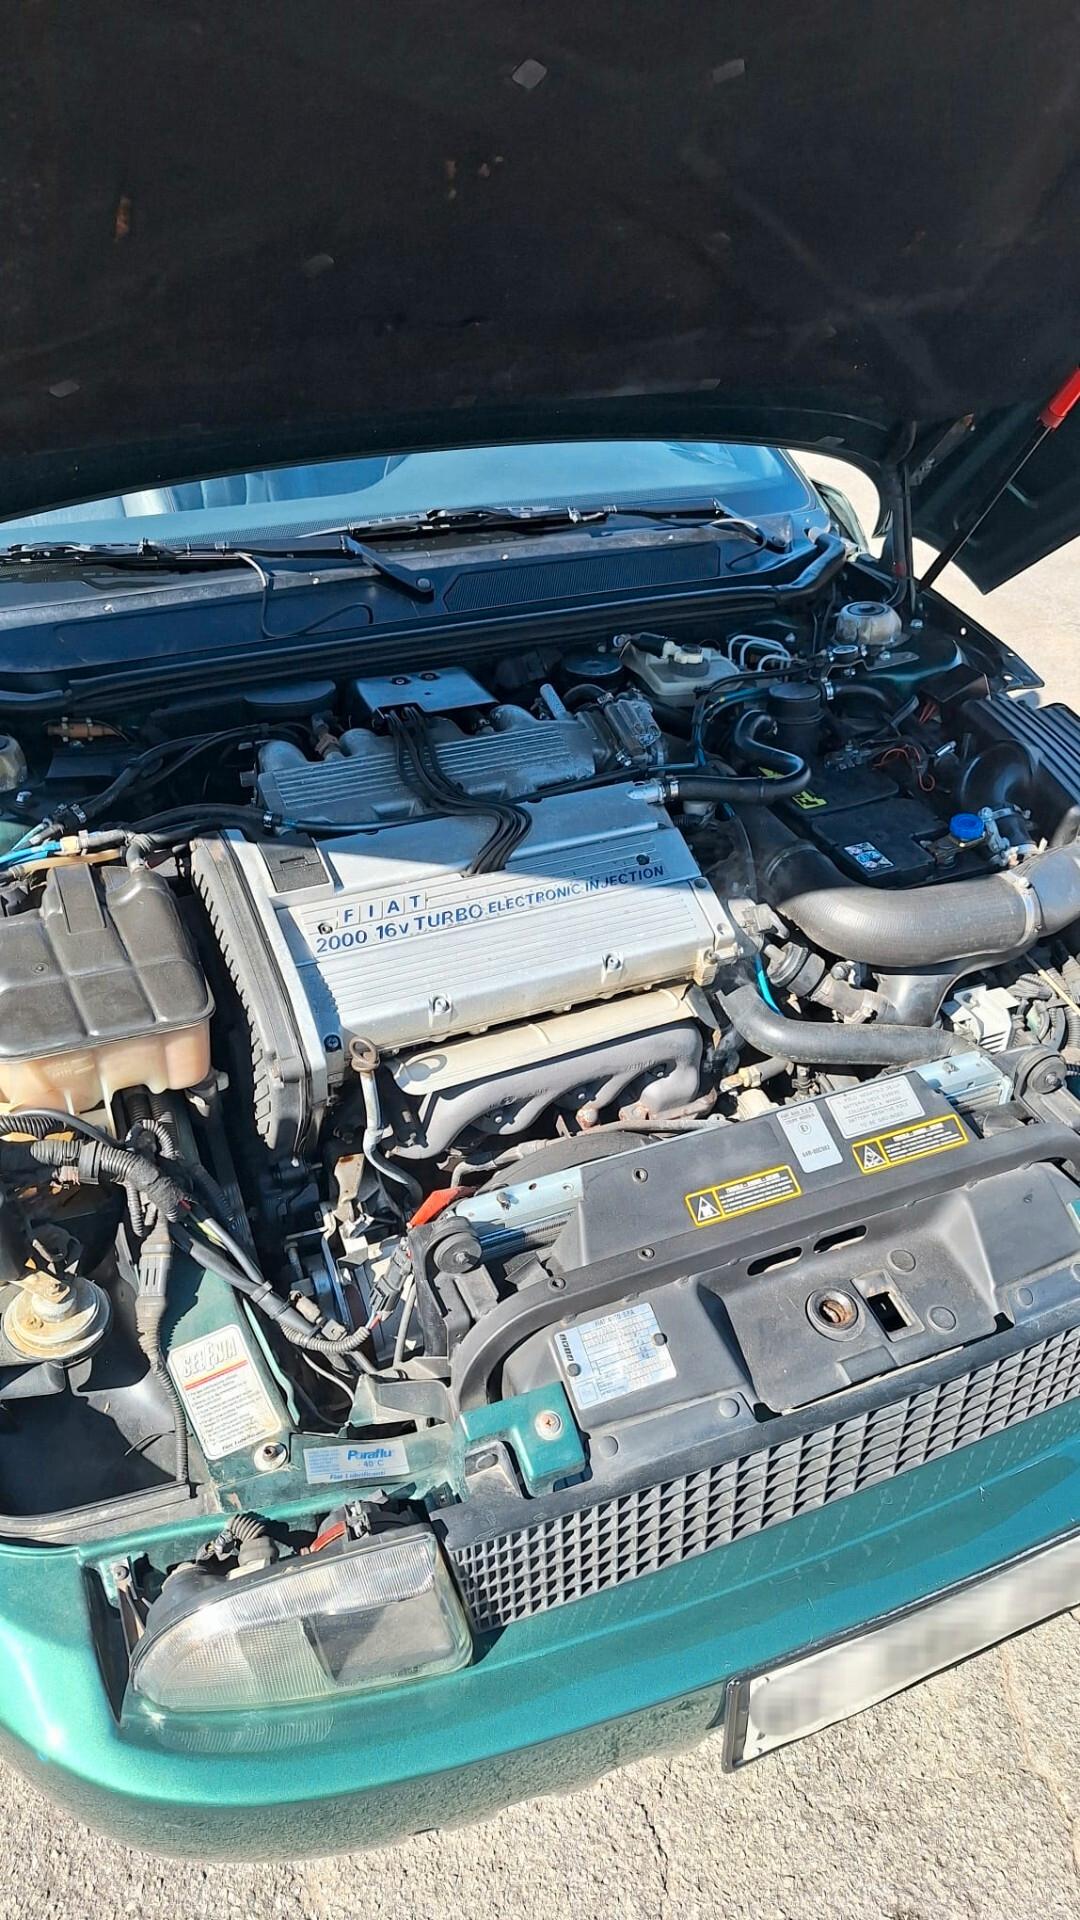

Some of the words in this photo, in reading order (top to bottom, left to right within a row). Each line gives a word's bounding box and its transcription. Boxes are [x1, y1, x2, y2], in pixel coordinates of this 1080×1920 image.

[316, 930, 368, 953] 2000
[375, 920, 410, 942] 16v
[414, 904, 483, 931] TURBO
[488, 881, 582, 915] ELECTRONIC
[584, 865, 665, 893] INJECTION
[343, 895, 422, 924] FIAT
